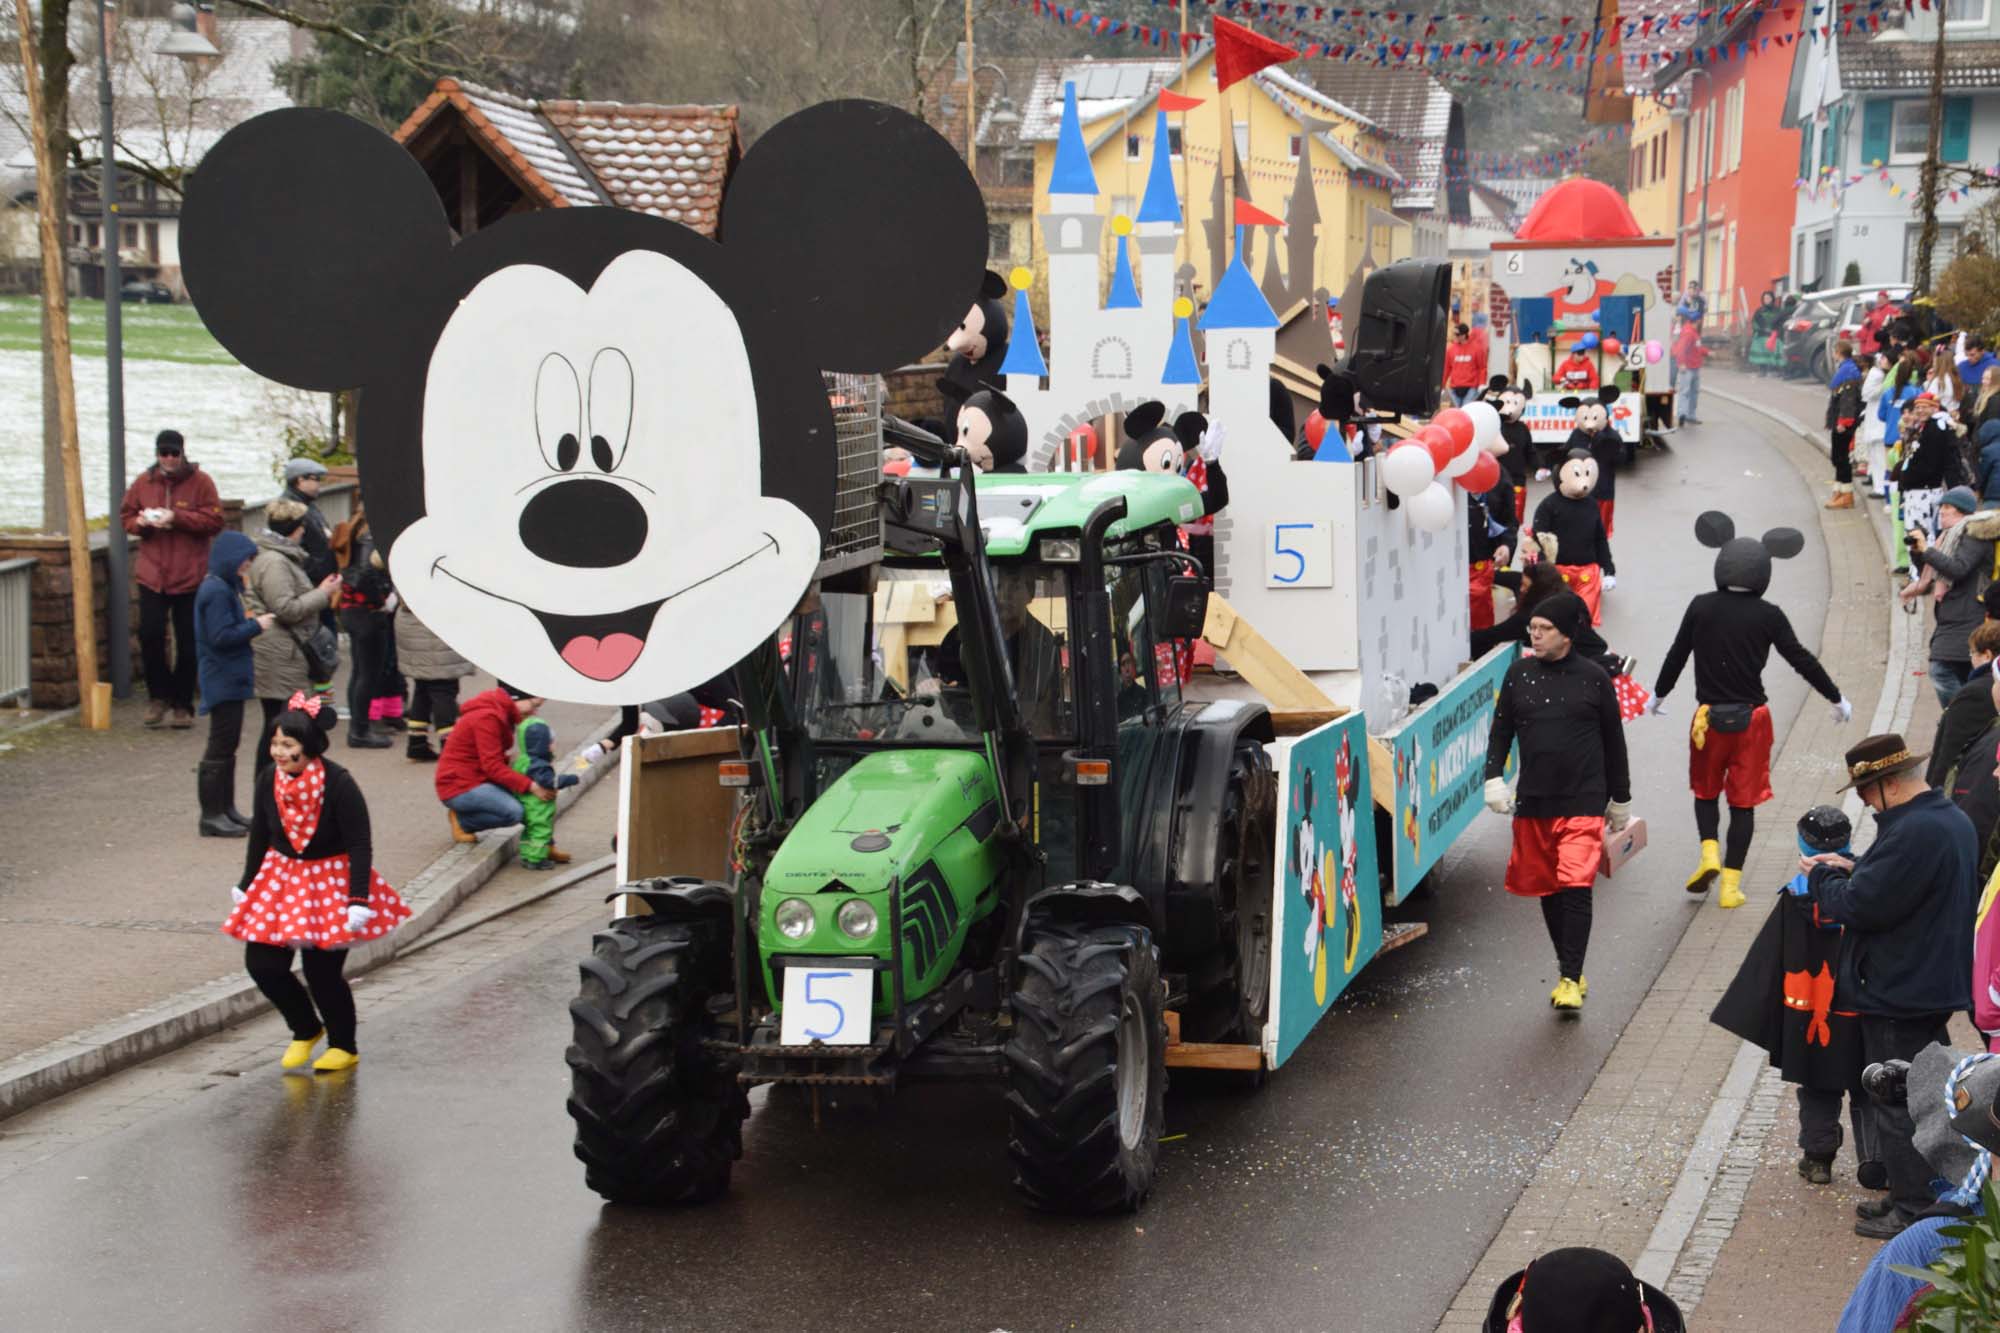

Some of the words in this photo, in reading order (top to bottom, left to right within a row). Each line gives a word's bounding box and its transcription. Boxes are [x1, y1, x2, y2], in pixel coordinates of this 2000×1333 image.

[1852, 225, 1869, 237] 38
[1508, 253, 1519, 273] 6
[1631, 346, 1643, 365] 6
[1273, 523, 1314, 583] 5
[803, 971, 853, 1040] 5
